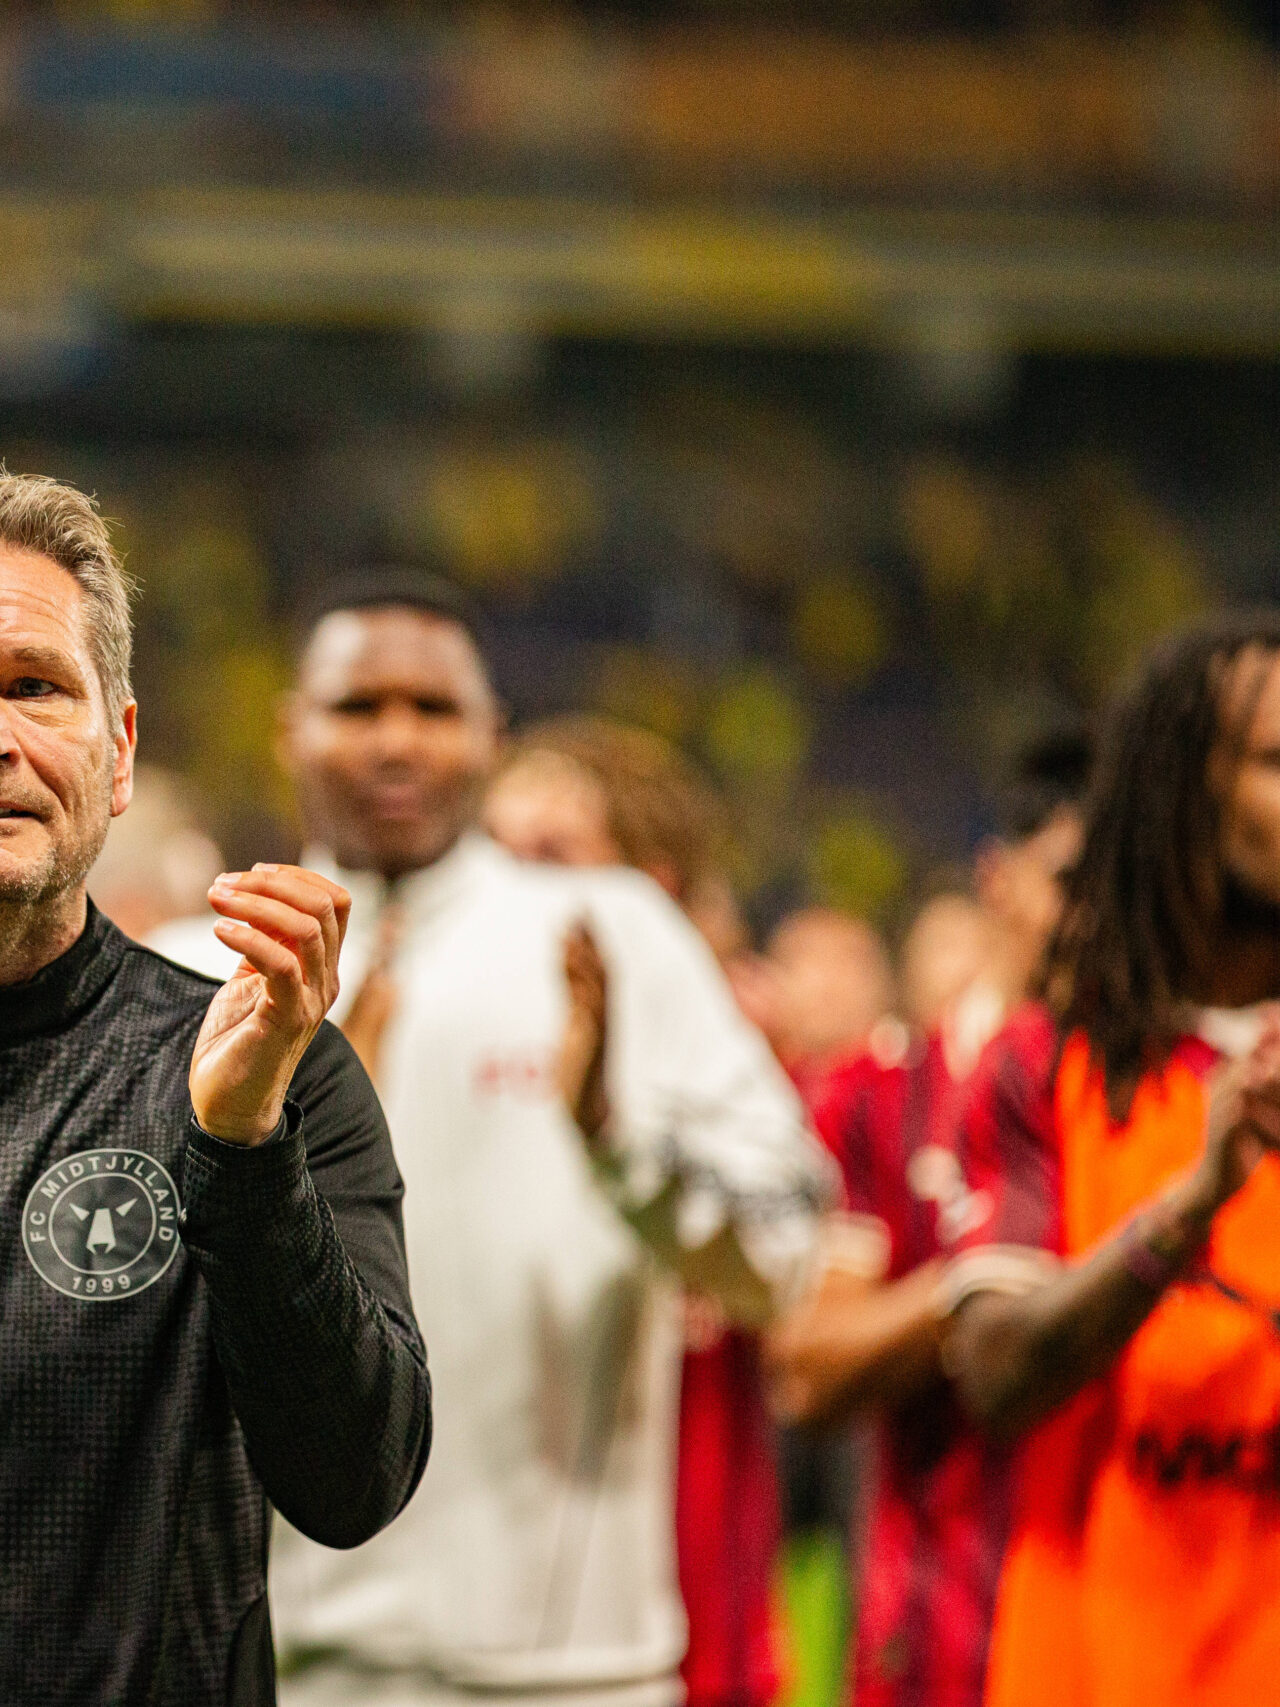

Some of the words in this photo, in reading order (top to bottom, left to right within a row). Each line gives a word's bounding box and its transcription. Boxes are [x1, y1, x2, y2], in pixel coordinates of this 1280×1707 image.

[30, 1211, 46, 1242] FC
[40, 1156, 174, 1241] MIDTJYLLAND
[72, 1274, 131, 1293] 1999
